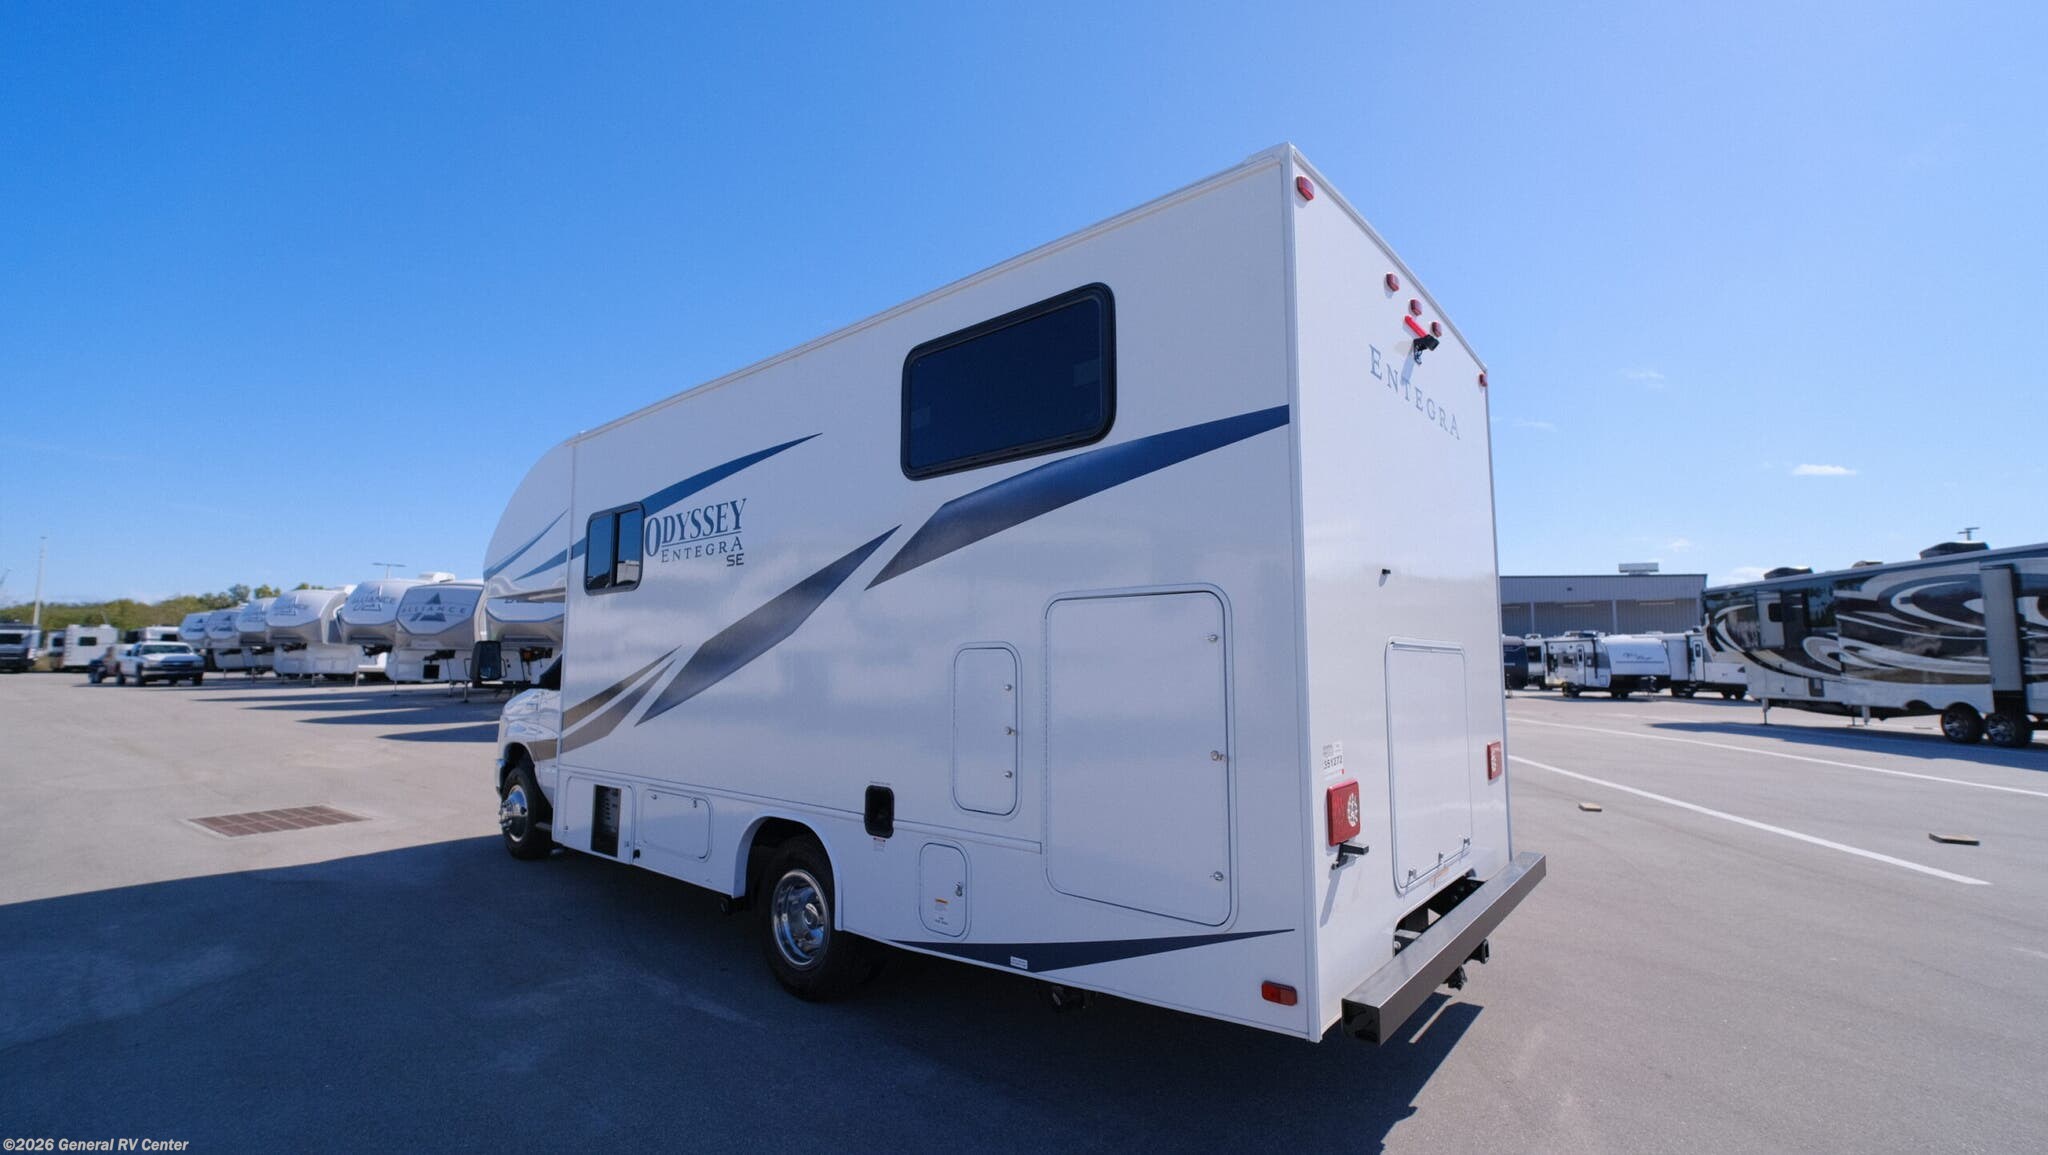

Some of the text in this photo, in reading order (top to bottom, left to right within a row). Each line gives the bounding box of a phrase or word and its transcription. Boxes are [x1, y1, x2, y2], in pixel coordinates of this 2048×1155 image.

[1369, 344, 1460, 440] ENTEGRA
[644, 498, 747, 557] ODYSSEY
[661, 536, 743, 563] ENTEGRA
[726, 553, 745, 567] SE
